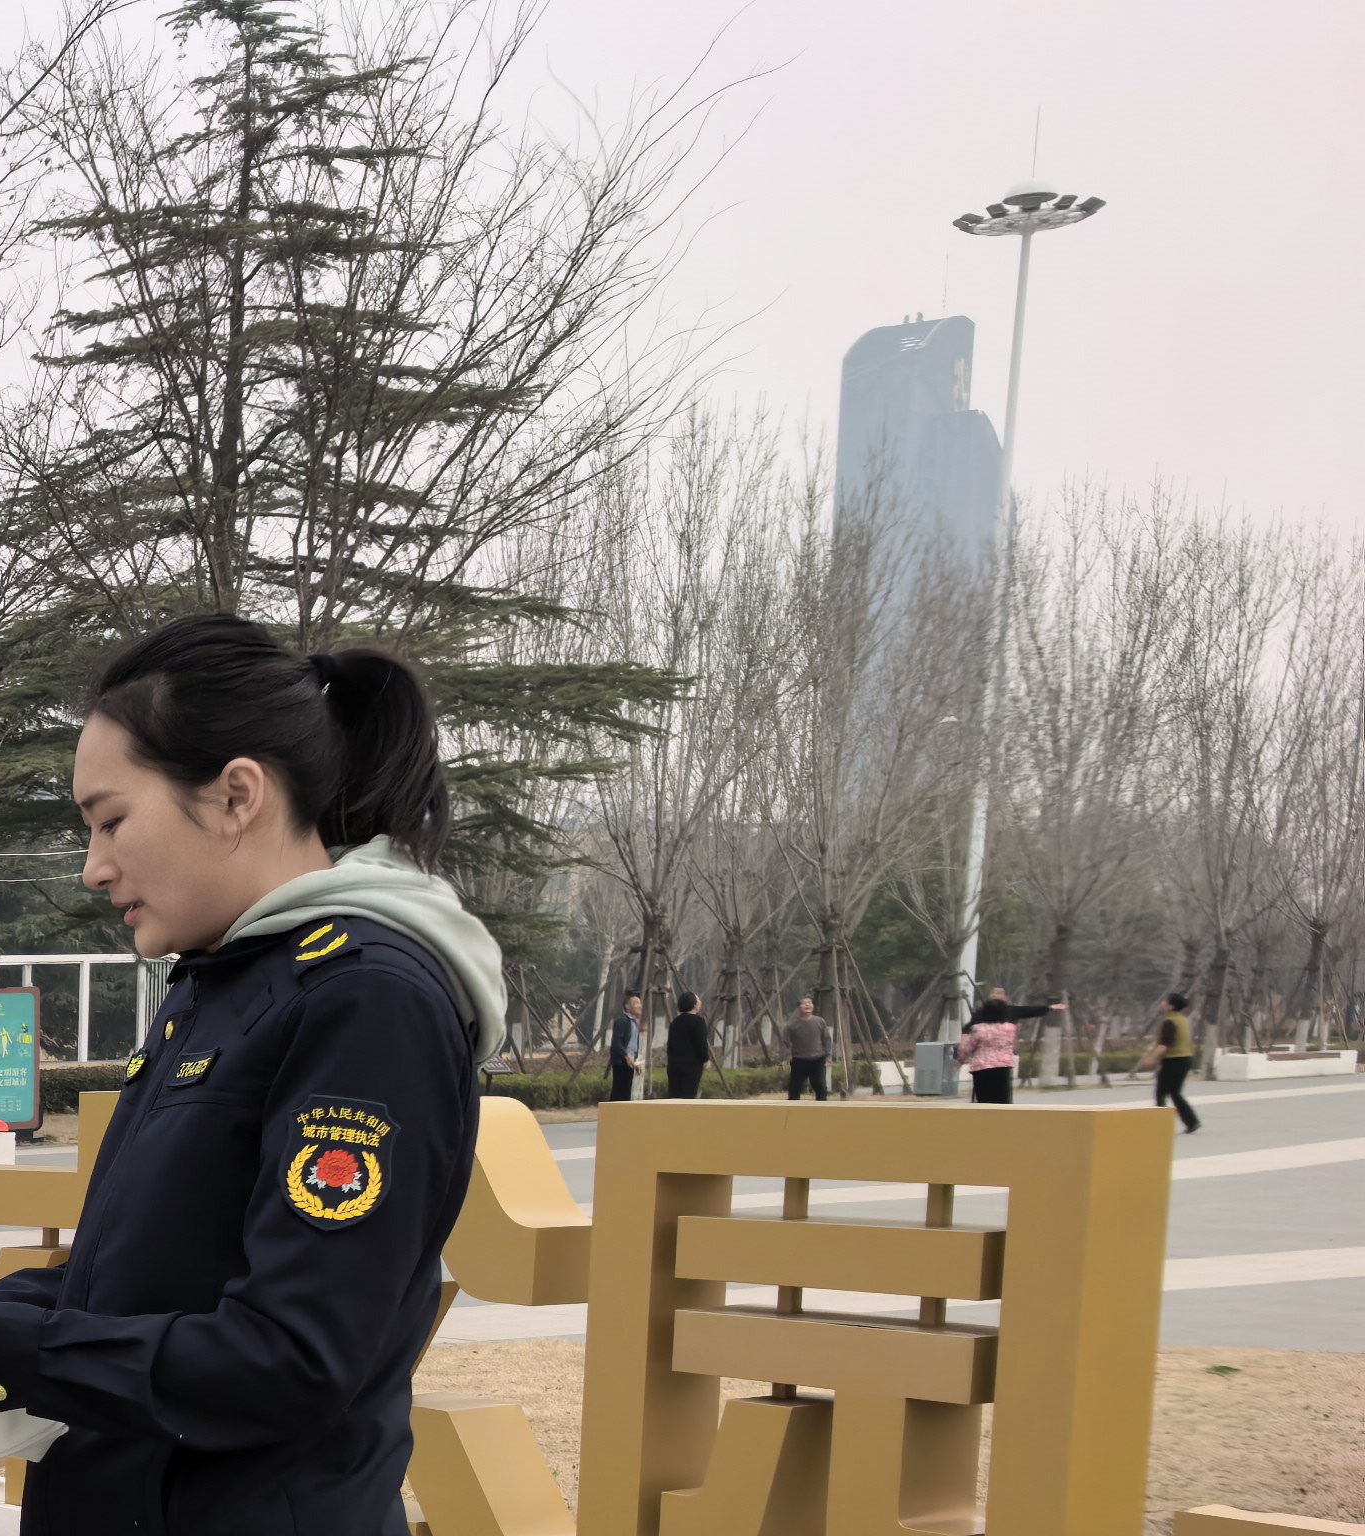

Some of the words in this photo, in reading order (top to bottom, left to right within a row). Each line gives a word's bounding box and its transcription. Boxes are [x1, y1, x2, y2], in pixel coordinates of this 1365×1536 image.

[296, 1106, 391, 1137] 中华人民共和国
[302, 1124, 381, 1148] 城市管理执法
